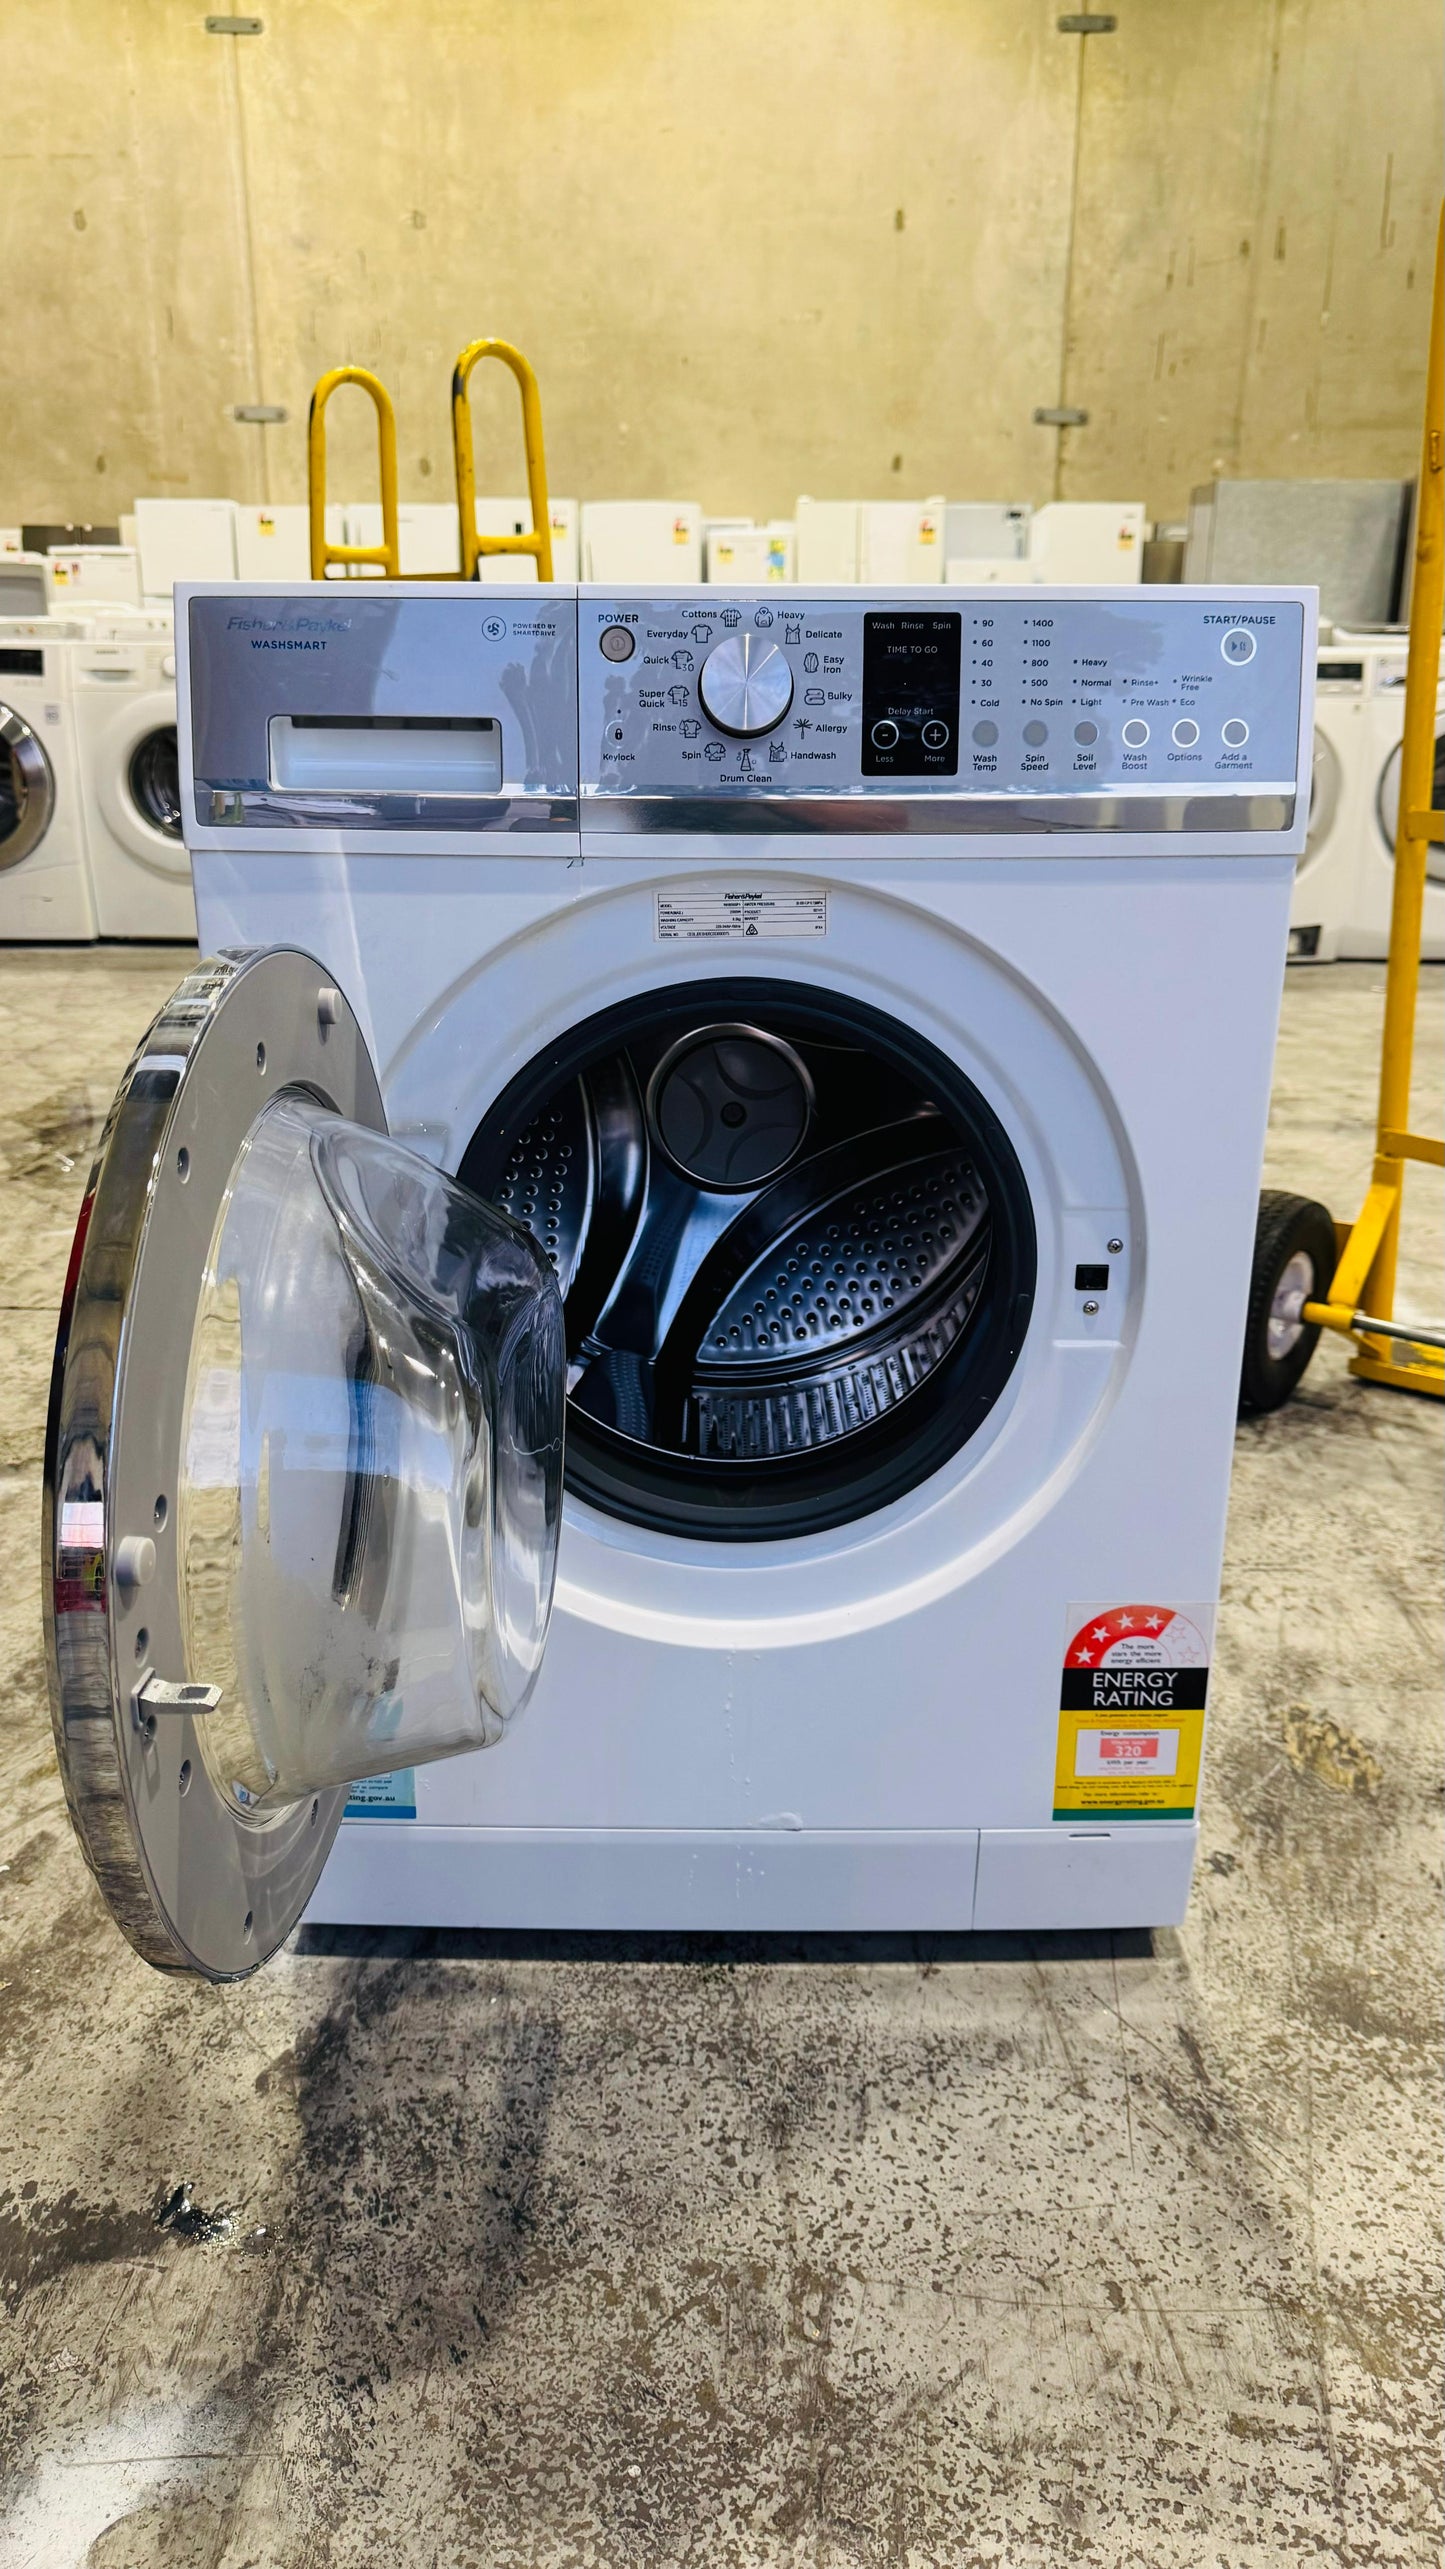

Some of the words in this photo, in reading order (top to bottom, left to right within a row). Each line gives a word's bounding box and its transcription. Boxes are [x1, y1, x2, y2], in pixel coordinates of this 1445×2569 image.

[598, 614, 638, 623] POWER
[682, 610, 717, 619] Cottons
[778, 611, 805, 620] Heavy
[982, 620, 994, 628] 90
[1032, 620, 1054, 628] 1400
[1203, 615, 1276, 625] START/PAUSE
[872, 622, 895, 630] Wash
[901, 622, 924, 630] Rinse
[933, 622, 951, 631] Spin
[647, 629, 688, 639] Everyday
[806, 630, 842, 639] Delicate
[251, 640, 328, 650] WASHSMART
[982, 639, 993, 647] 60
[1032, 639, 1051, 647] 1100
[887, 646, 908, 654] TIME
[910, 646, 922, 654] TO
[924, 646, 938, 654] GO
[644, 656, 669, 666] Quick
[824, 656, 844, 666] Easy
[981, 659, 993, 667] 40
[1031, 659, 1049, 667] 800
[1081, 658, 1108, 668] Heavy
[682, 664, 694, 672] 30
[824, 665, 841, 673] Iron
[980, 679, 992, 687] 30
[1031, 679, 1048, 687] 500
[1081, 679, 1112, 687] Normal
[1131, 679, 1159, 687] Rinse+
[1182, 674, 1213, 683] Wrinkle
[1181, 683, 1200, 692] Free
[639, 690, 665, 699] Super
[828, 692, 852, 701] Bulky
[639, 699, 665, 709] Quick
[678, 699, 688, 707] 15
[980, 699, 1000, 707] Cold
[1030, 698, 1041, 706] No
[1044, 698, 1063, 708] Spin
[1081, 698, 1102, 707] Light
[1131, 698, 1145, 706] Pre
[1147, 698, 1169, 706] Wash
[1180, 698, 1195, 706] Eco
[888, 707, 911, 717] Delay
[913, 707, 934, 716] Start
[653, 723, 677, 732] Rinse
[816, 724, 847, 734] Allergy
[603, 753, 635, 762] Keylock
[682, 751, 701, 760] Spin
[790, 751, 836, 759] Handwash
[875, 755, 894, 763] Less
[925, 755, 945, 763] More
[973, 754, 997, 763] Wash
[1025, 754, 1045, 763] Spin
[1077, 754, 1094, 762] Soil
[1123, 753, 1147, 762] Wash
[1168, 753, 1202, 763] Options
[1221, 753, 1238, 762] Add
[973, 763, 997, 772] Temp
[1021, 762, 1049, 772] Speed
[1073, 762, 1096, 771] Level
[1122, 761, 1148, 770] Boost
[1215, 761, 1253, 770] Garment
[747, 774, 772, 782] Clean
[1092, 1672, 1178, 1688] ENERGY
[1093, 1691, 1174, 1706] RATING
[1115, 1746, 1142, 1756] 320
[348, 1794, 395, 1802] ting.gov.au
